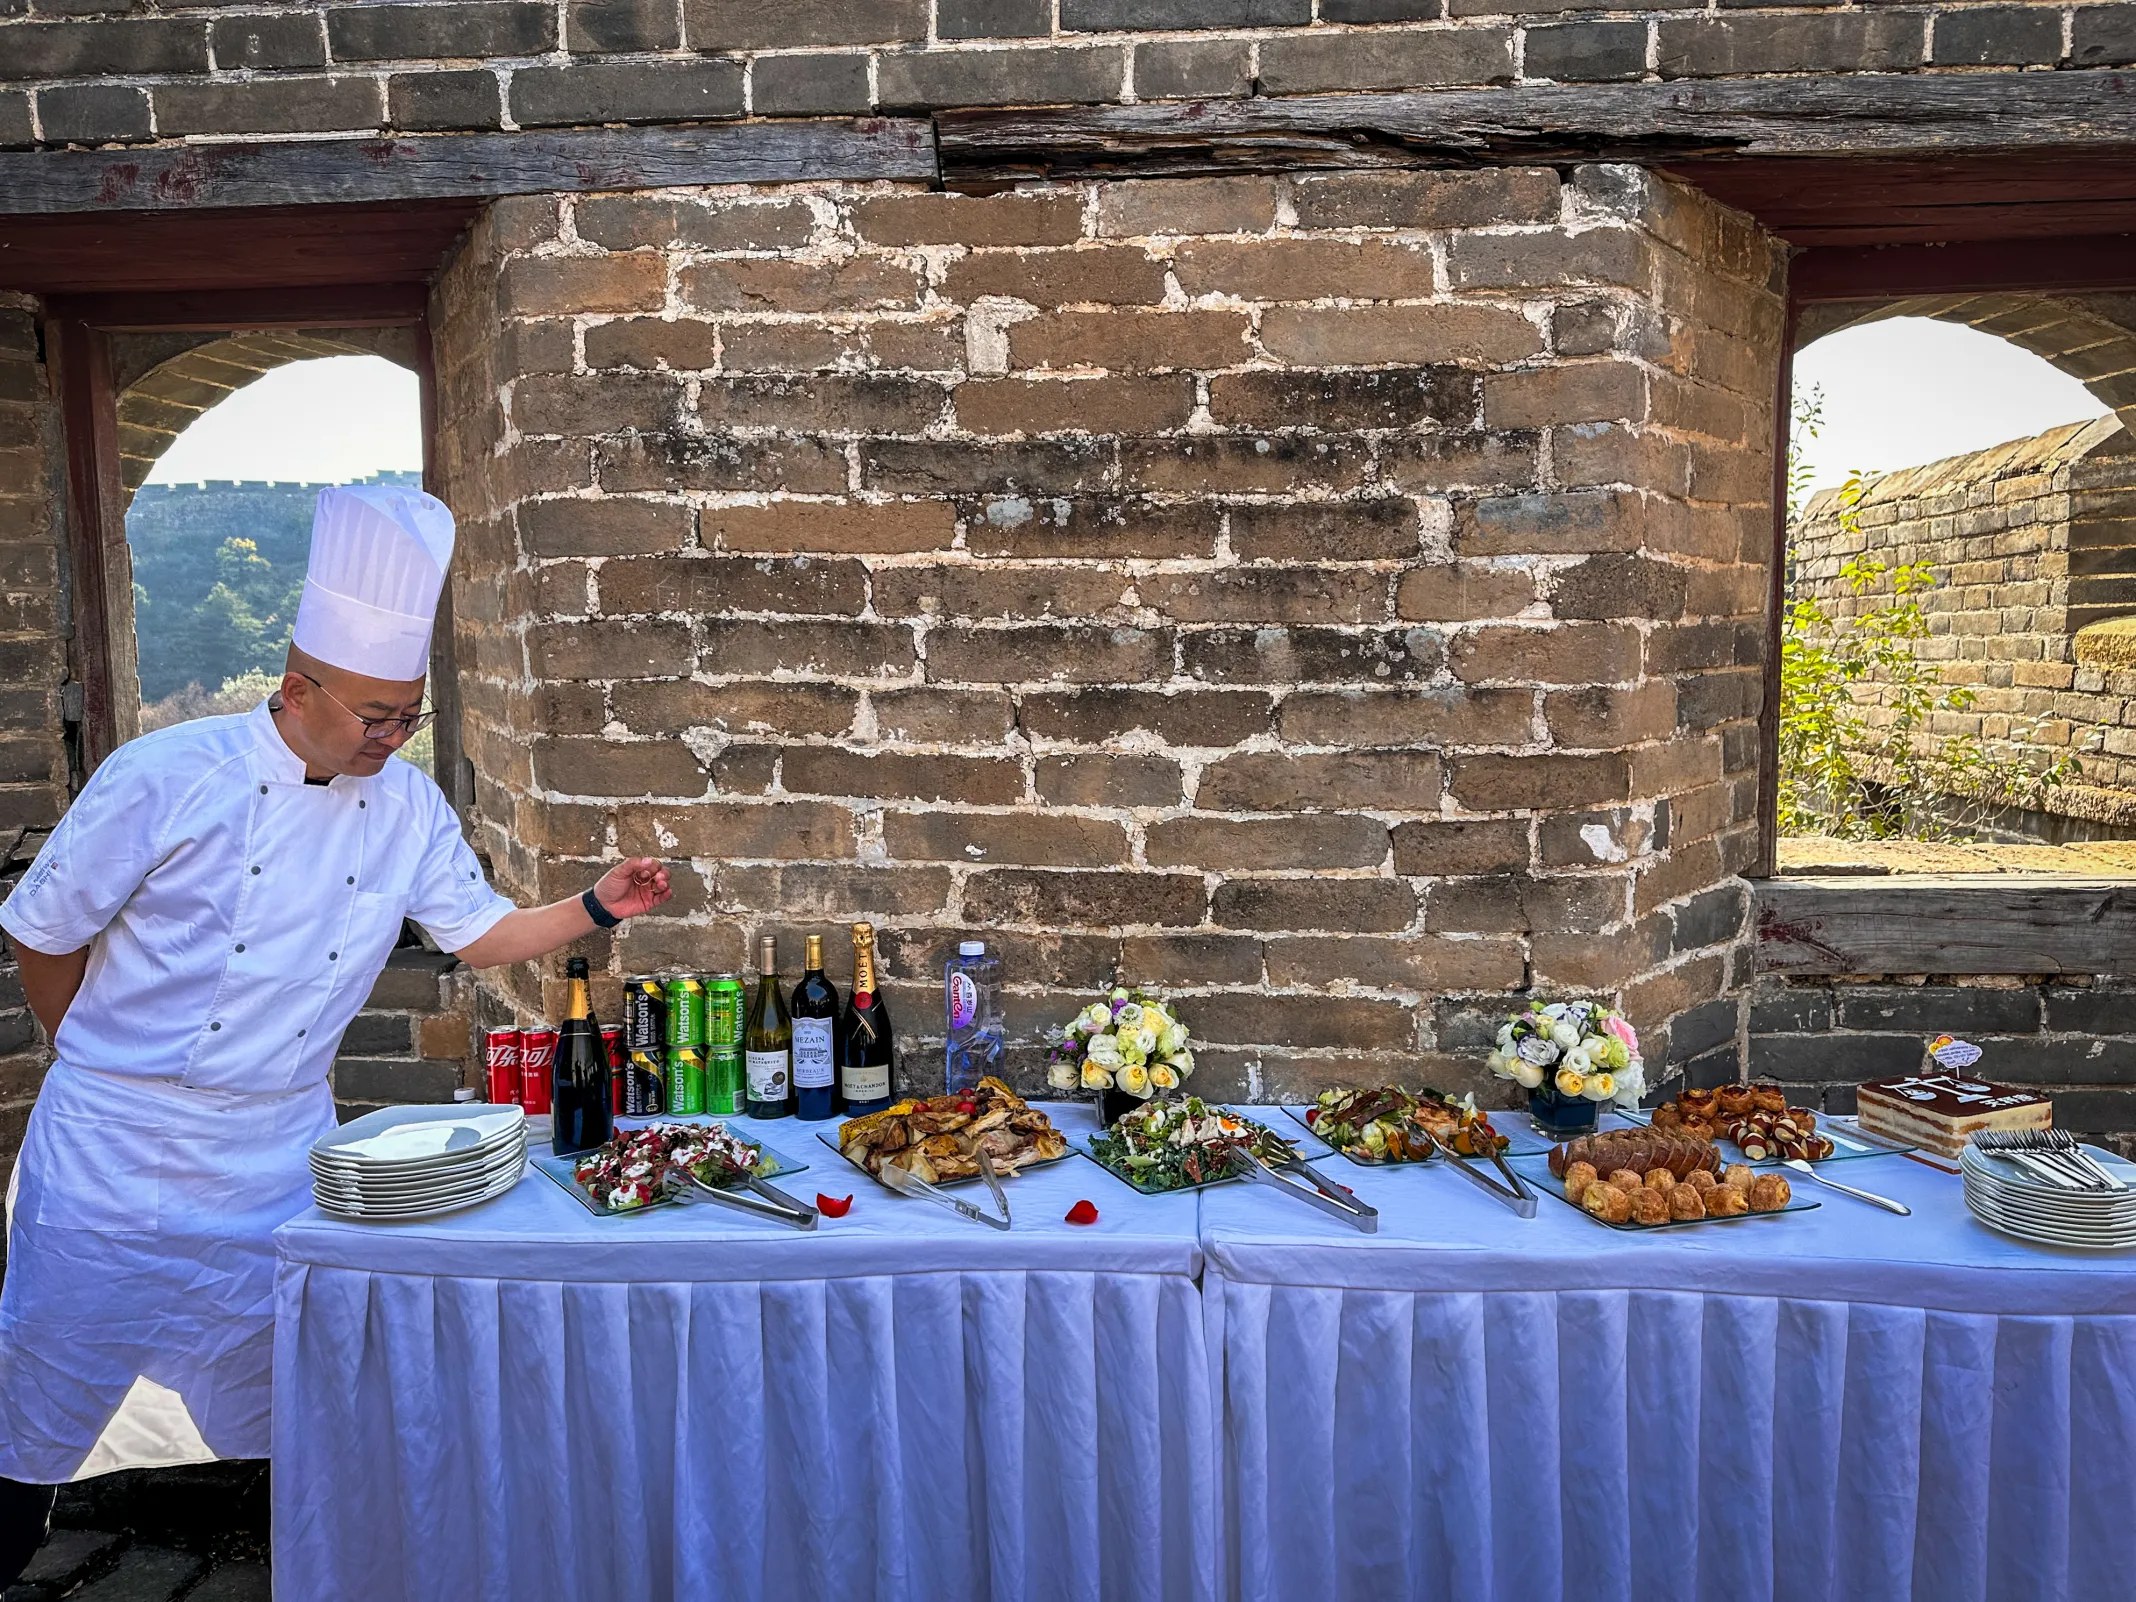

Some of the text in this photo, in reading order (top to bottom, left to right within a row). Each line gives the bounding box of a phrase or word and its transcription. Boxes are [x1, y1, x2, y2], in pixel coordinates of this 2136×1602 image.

[635, 994, 649, 1047] Watson's
[677, 991, 690, 1043] Watson's
[733, 990, 744, 1043] Watson's
[625, 1062, 635, 1113] Watson's
[672, 1061, 685, 1112] Watson's
